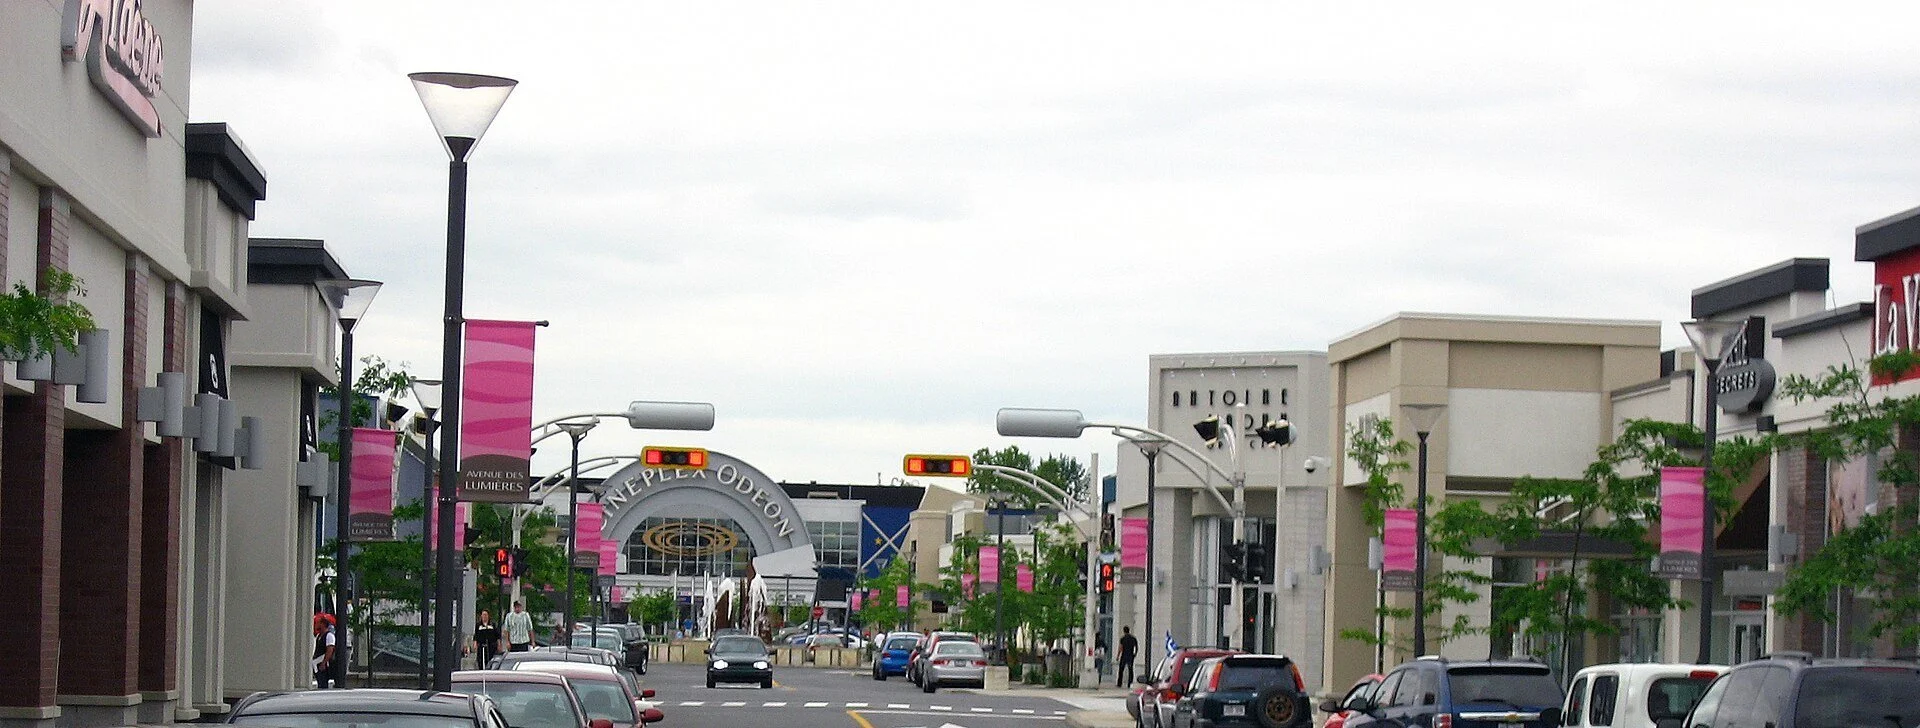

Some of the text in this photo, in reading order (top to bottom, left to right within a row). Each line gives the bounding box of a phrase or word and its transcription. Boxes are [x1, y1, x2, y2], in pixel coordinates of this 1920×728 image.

[1172, 388, 1288, 407] ANTOINE
[466, 470, 524, 479] AVENUE DES
[465, 479, 523, 492] LUMIÈRES
[717, 464, 795, 537] ODEON
